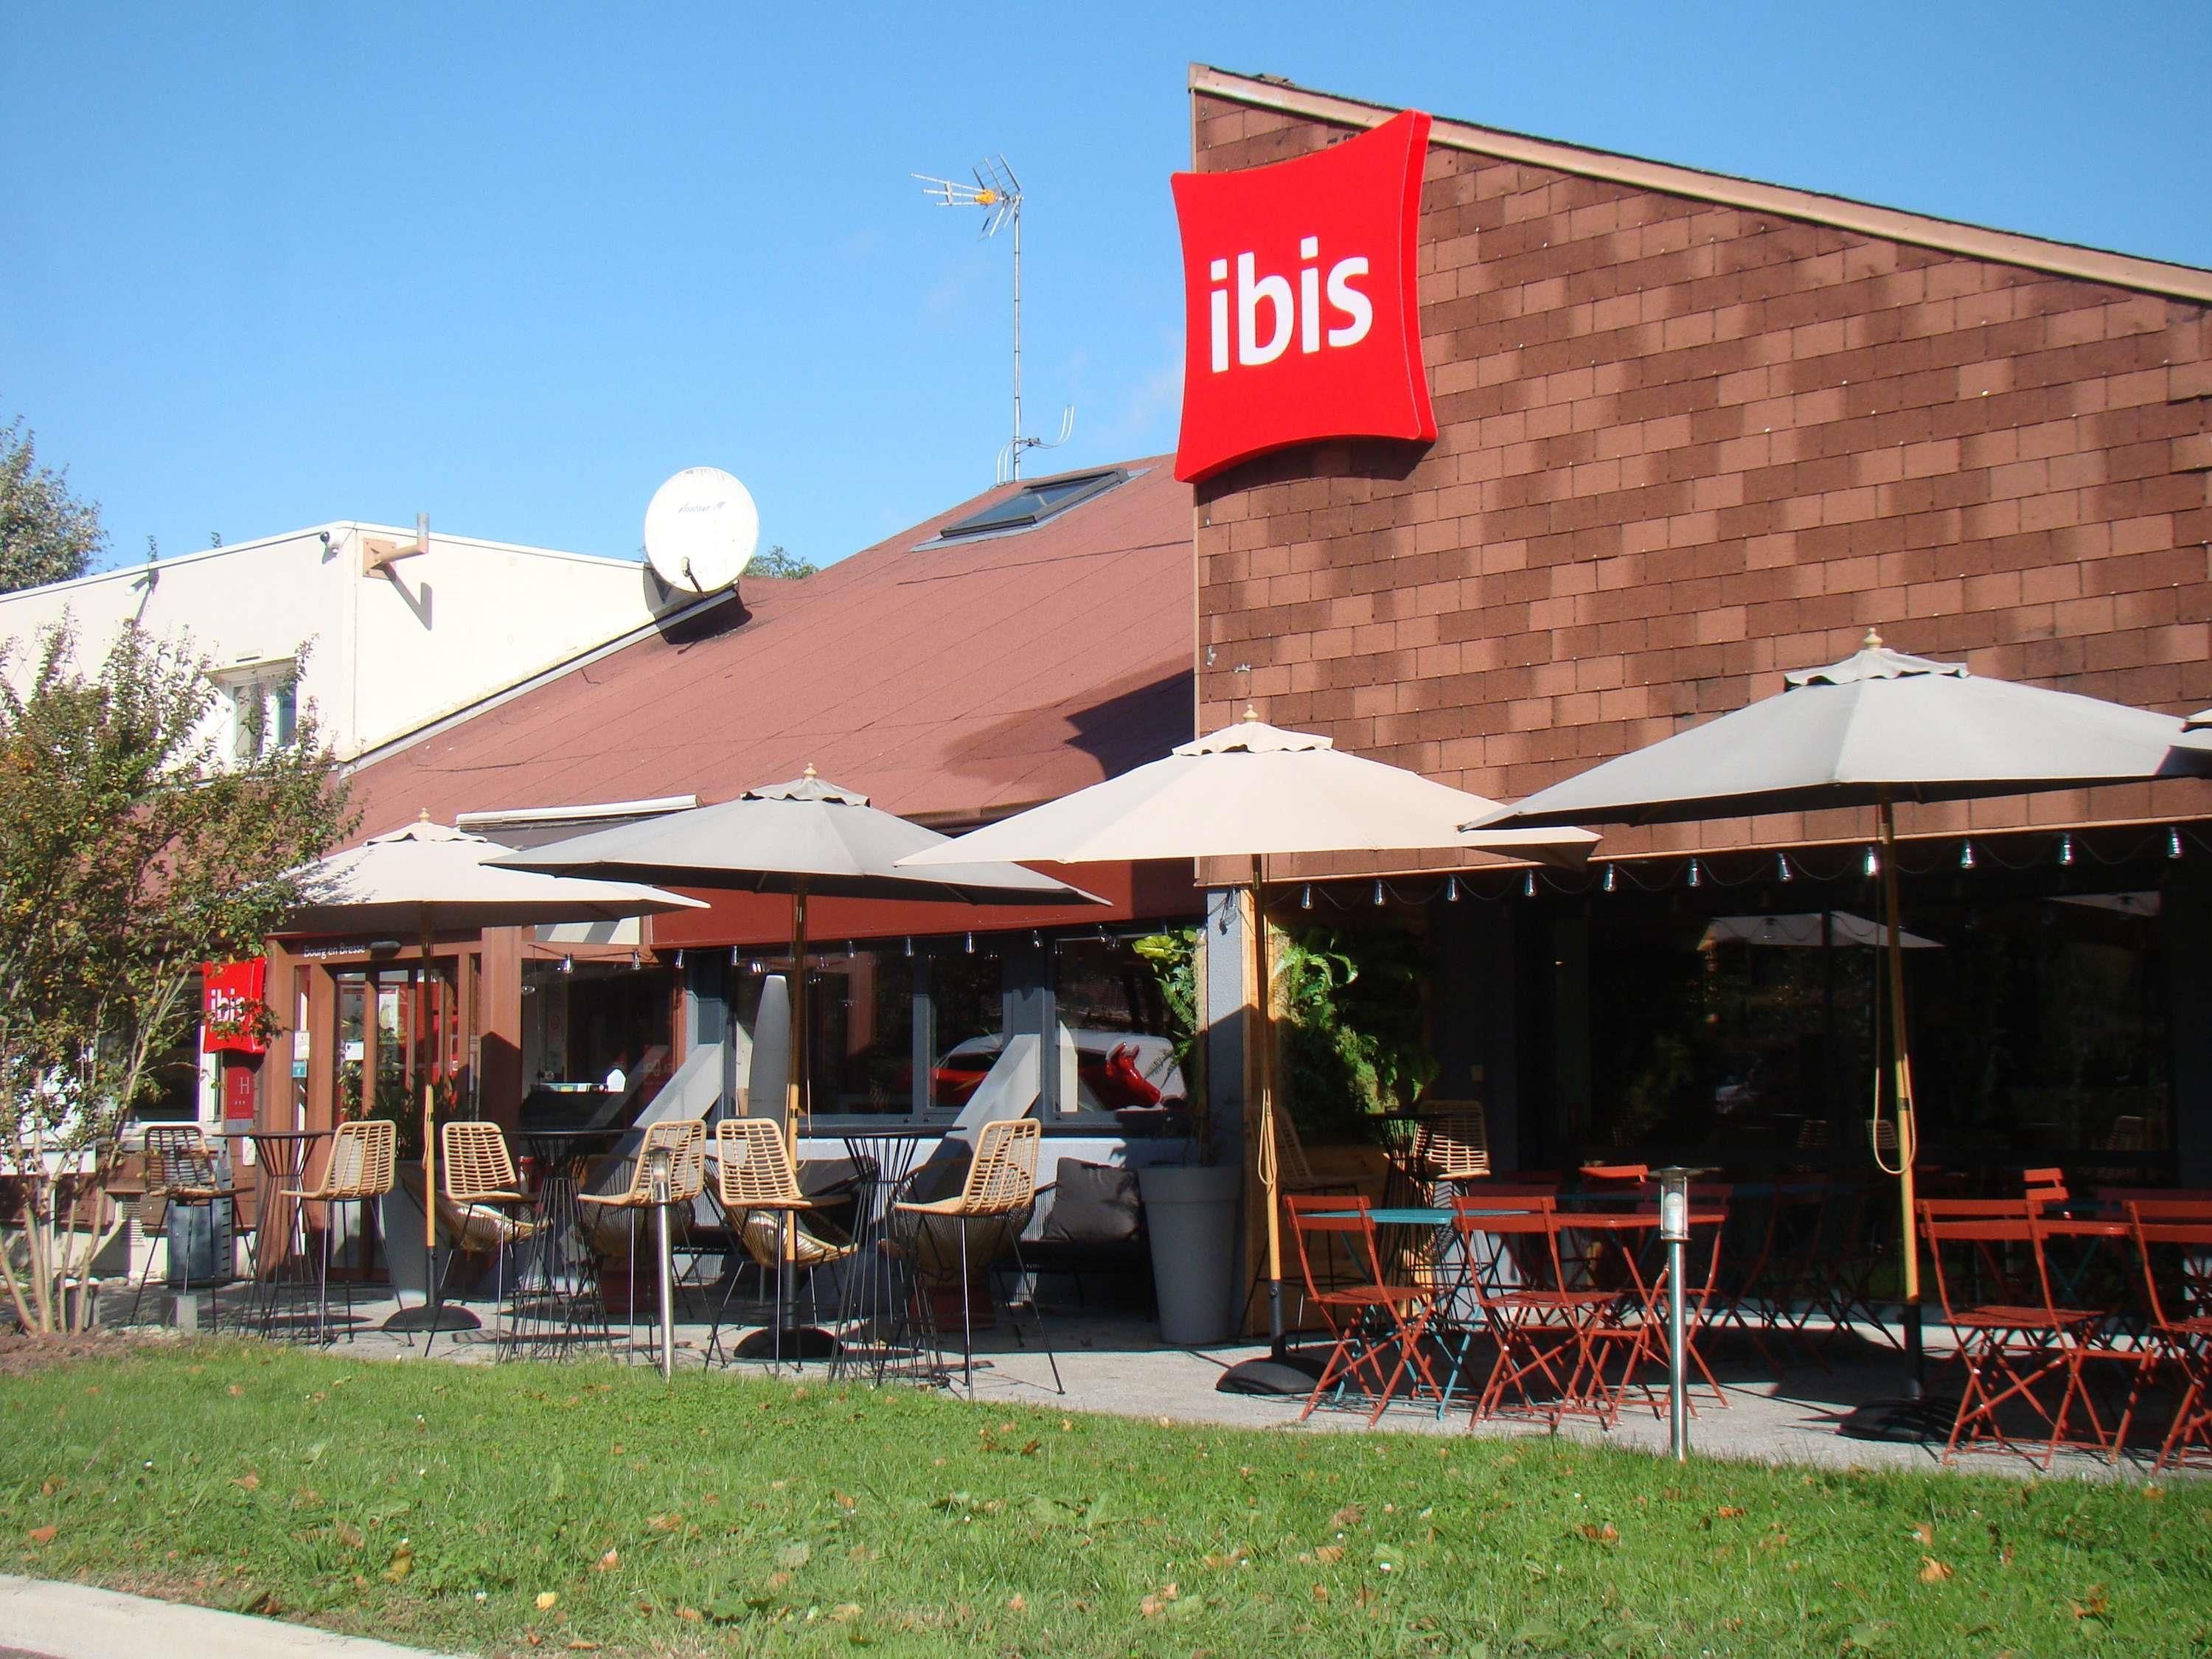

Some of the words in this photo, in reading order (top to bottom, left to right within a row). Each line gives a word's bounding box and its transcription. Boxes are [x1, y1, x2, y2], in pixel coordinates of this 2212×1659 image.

[1210, 235, 1374, 373] ibis
[304, 945, 327, 959] Bourg
[327, 947, 338, 956] en
[340, 942, 366, 955] Bresse
[211, 988, 246, 1024] ibis
[240, 1077, 250, 1094] H
